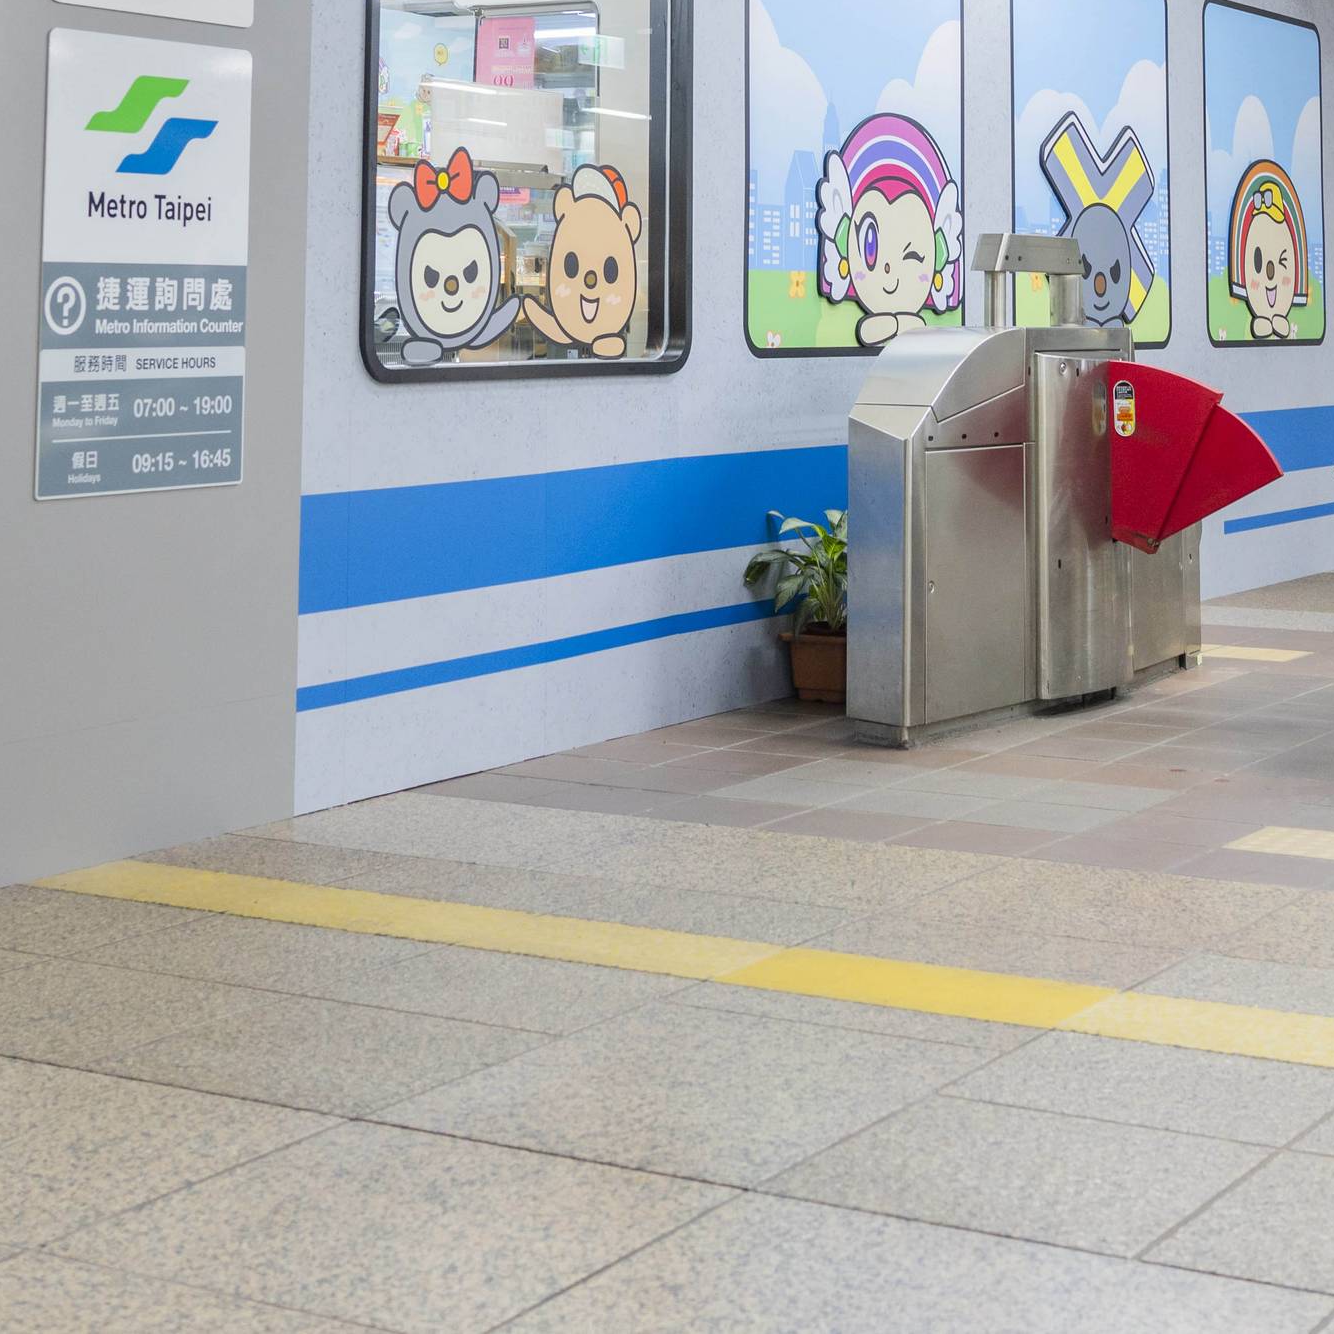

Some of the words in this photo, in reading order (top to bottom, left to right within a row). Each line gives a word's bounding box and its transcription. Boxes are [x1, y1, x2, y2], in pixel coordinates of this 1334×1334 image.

[87, 190, 147, 220] Metro
[154, 194, 213, 227] Taipei
[95, 276, 233, 313] 捷運詢問處
[94, 318, 130, 335] Metro
[132, 318, 197, 335] Information
[199, 319, 244, 335] Counter
[73, 354, 128, 374] 服務時間
[135, 356, 178, 371] SERVICE
[181, 355, 216, 370] HOURS
[52, 393, 120, 414] 週一至週五
[133, 397, 175, 419] 07:00
[193, 394, 233, 416] 19:00
[51, 415, 82, 429] Monday
[84, 416, 93, 427] to
[94, 413, 119, 428] Friday
[71, 451, 98, 470] 假日
[132, 451, 174, 474] 09:15
[191, 448, 232, 470] 16:45
[67, 472, 101, 486] Holidays
